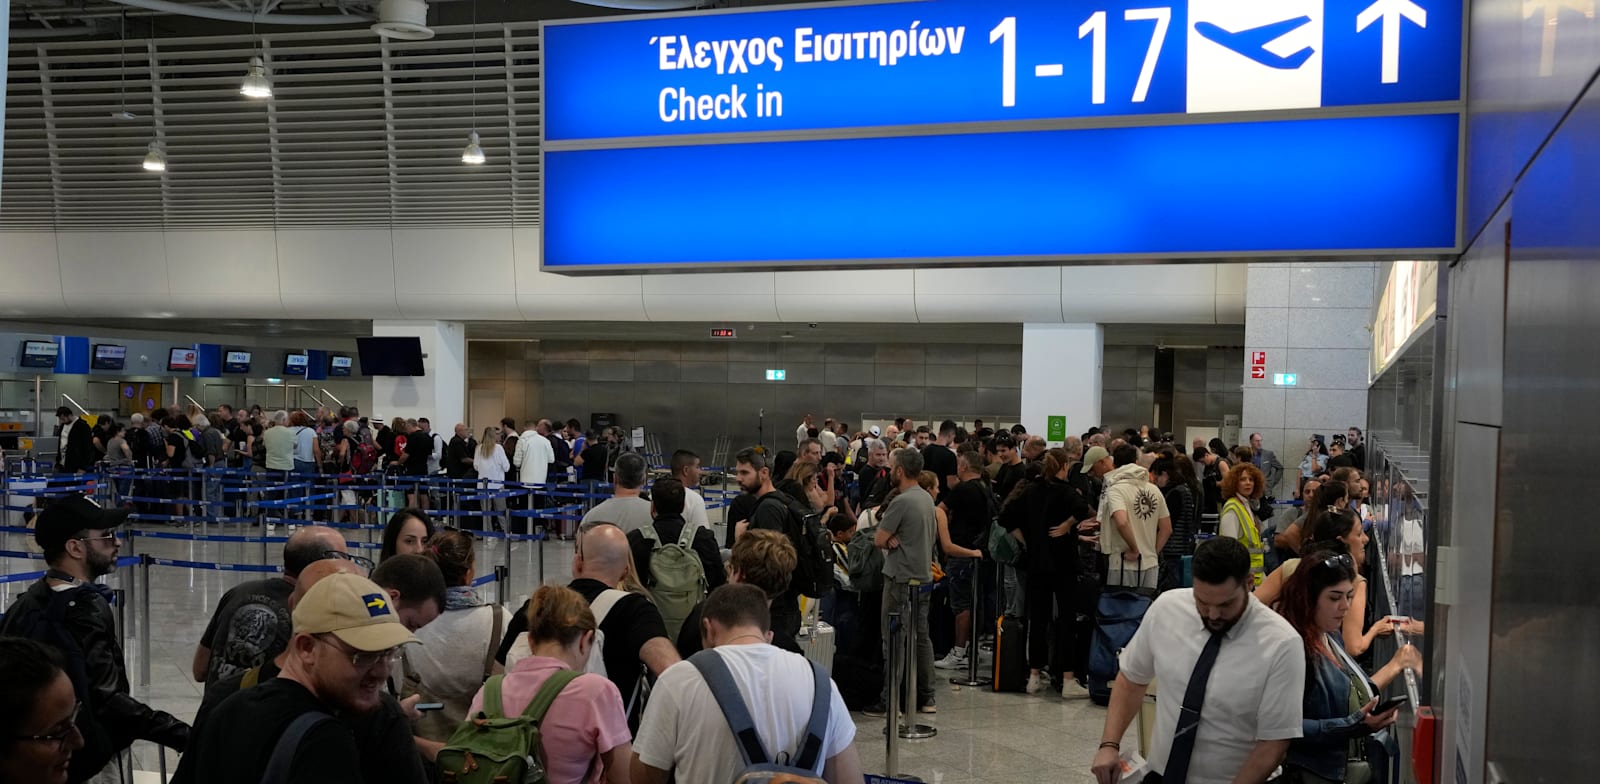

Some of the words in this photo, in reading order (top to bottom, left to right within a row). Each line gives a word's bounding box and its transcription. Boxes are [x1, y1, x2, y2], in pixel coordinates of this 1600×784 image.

[650, 35, 784, 75] Έλεγχος
[794, 20, 966, 66] Εισιτηρίων
[989, 6, 1172, 107] 1-17
[659, 83, 748, 122] Check
[756, 83, 783, 117] in
